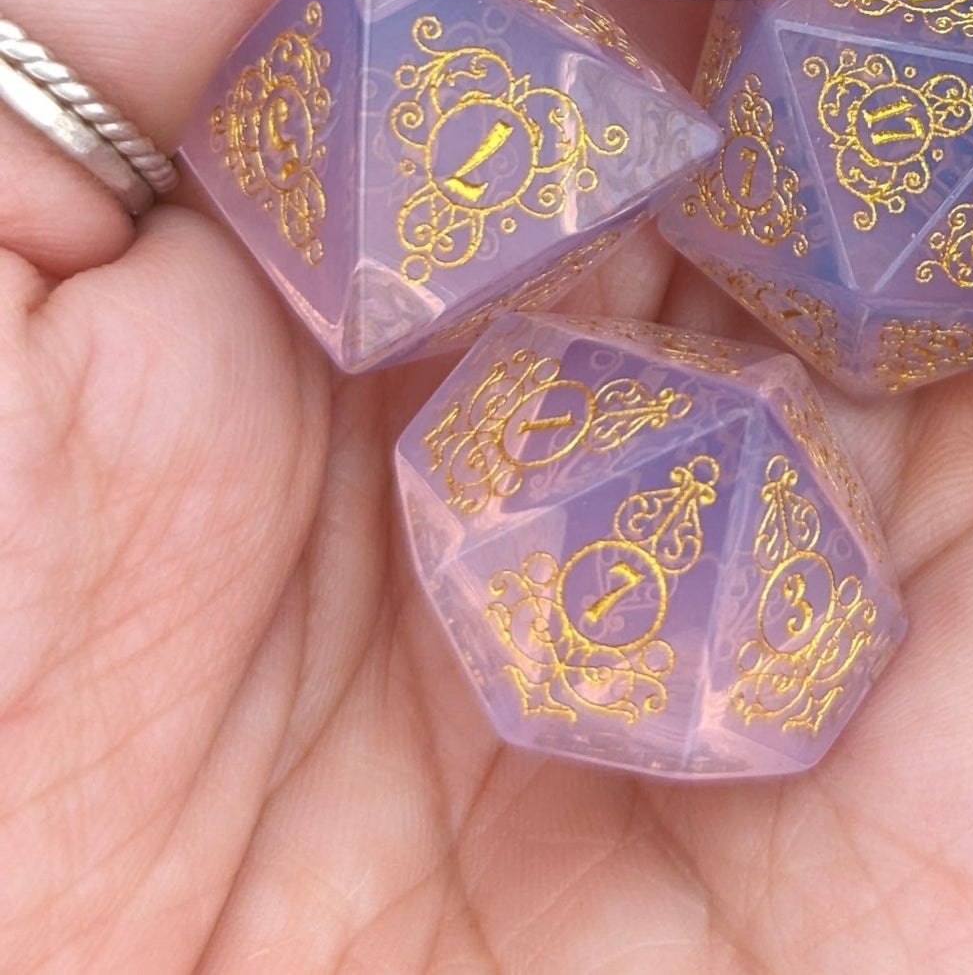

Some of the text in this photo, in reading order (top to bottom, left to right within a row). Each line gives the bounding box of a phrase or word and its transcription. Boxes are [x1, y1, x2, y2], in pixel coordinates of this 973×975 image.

[862, 95, 925, 145] 17
[445, 121, 513, 201] 7
[739, 146, 758, 198] 7
[519, 413, 576, 436] 1
[585, 560, 645, 622] 7
[782, 573, 813, 634] 3
